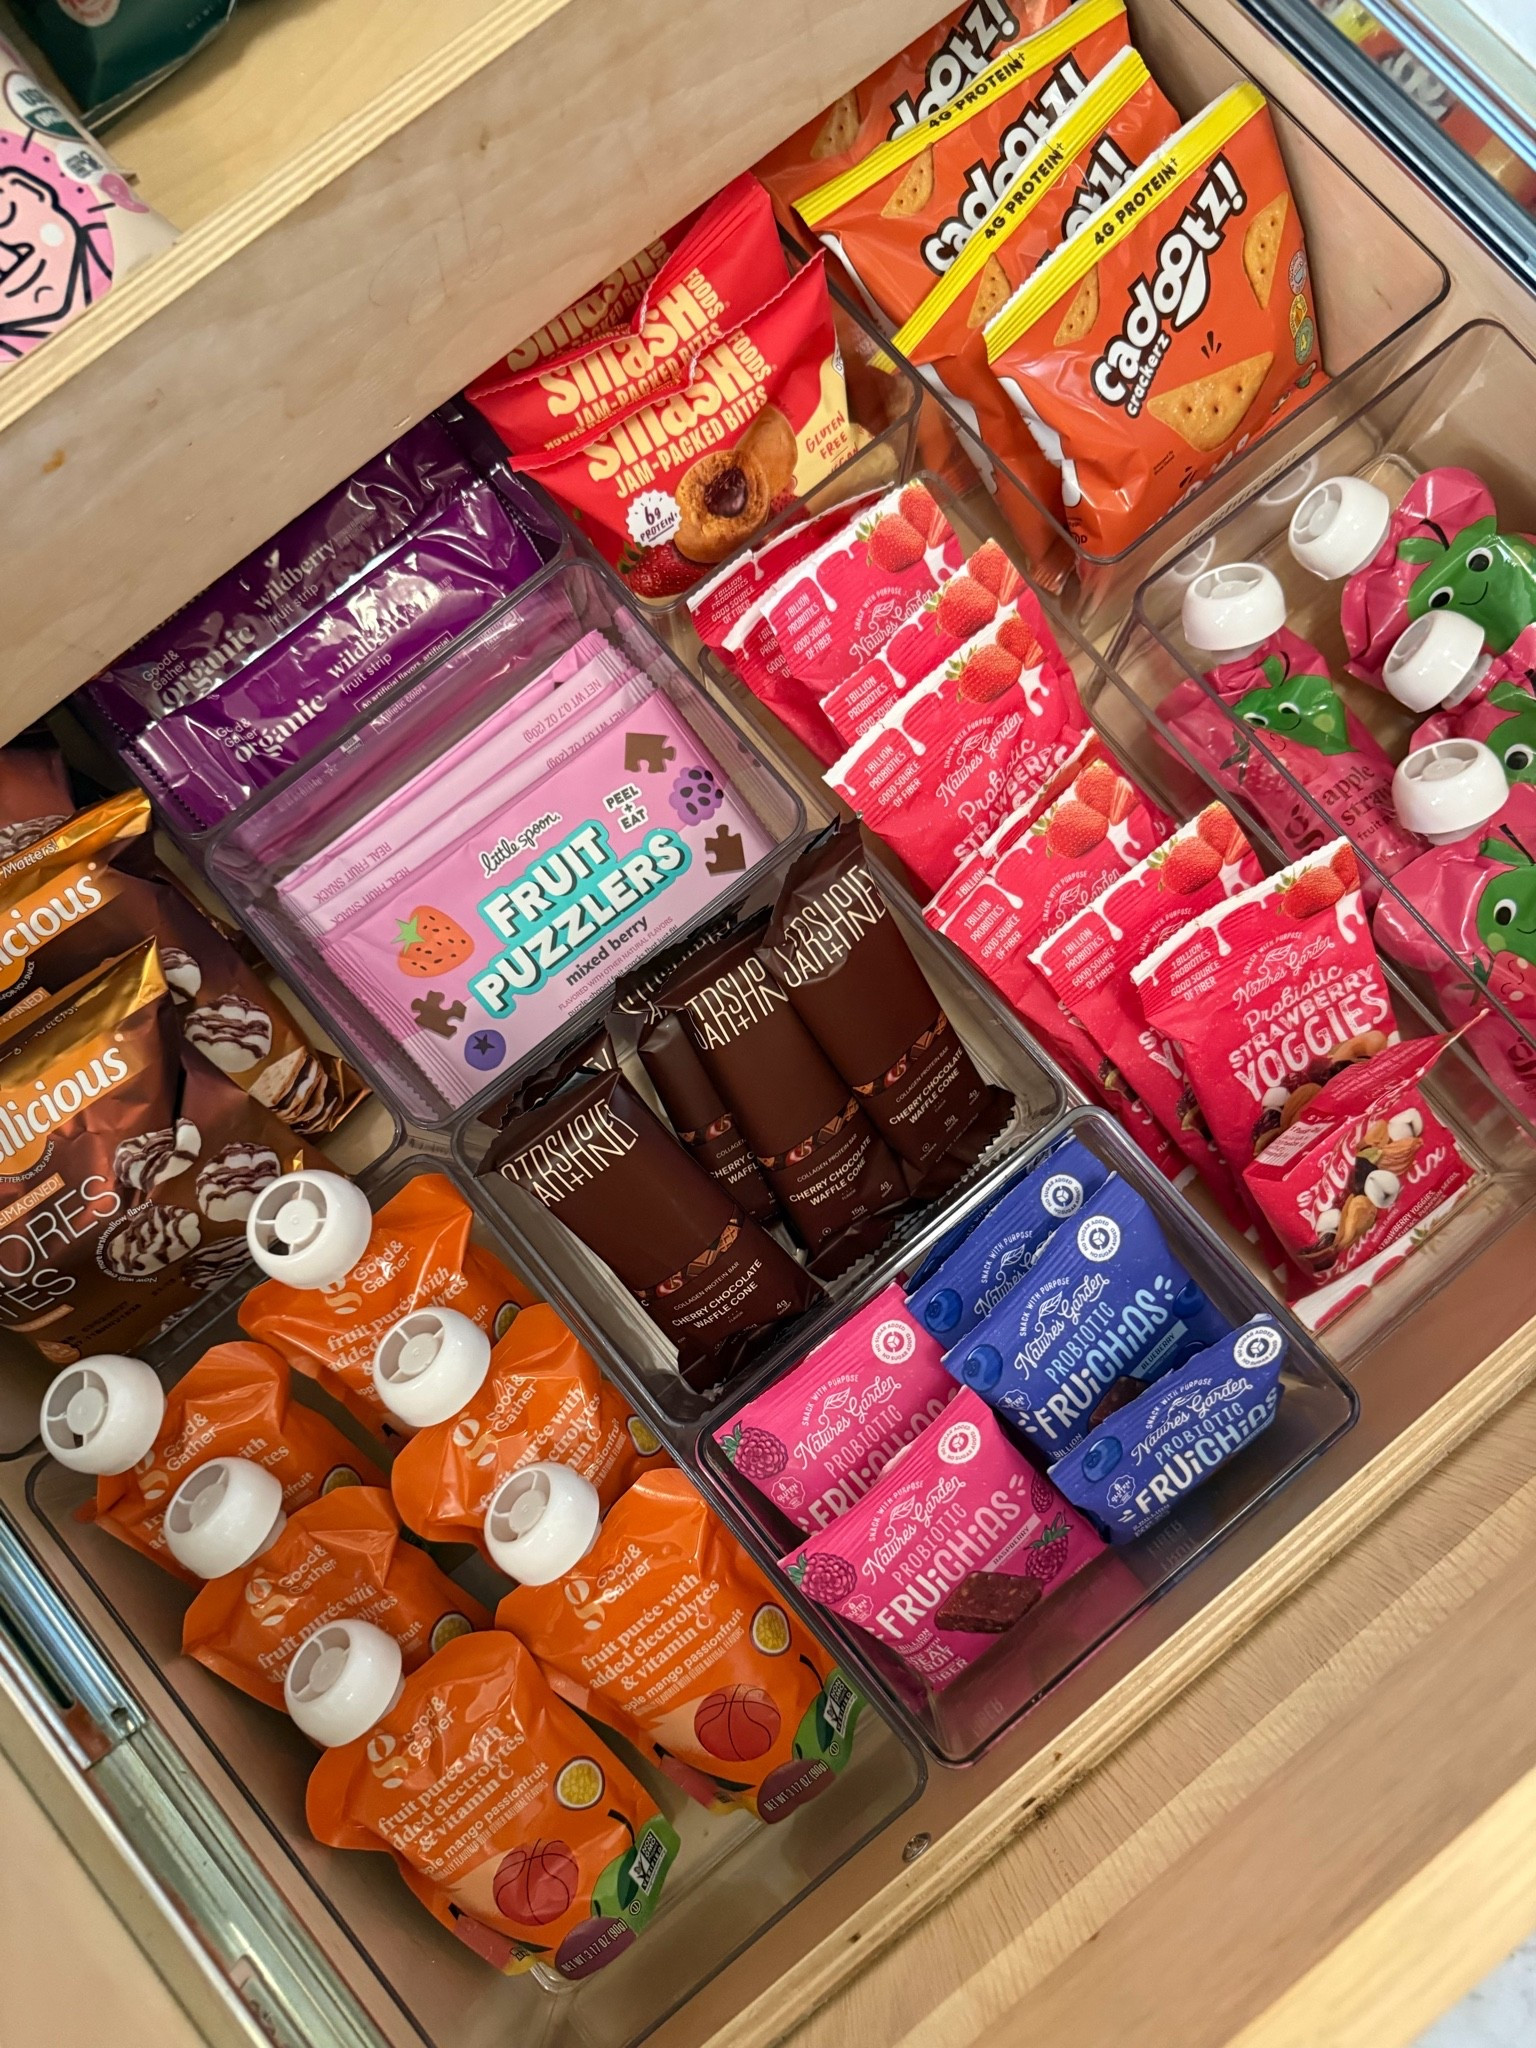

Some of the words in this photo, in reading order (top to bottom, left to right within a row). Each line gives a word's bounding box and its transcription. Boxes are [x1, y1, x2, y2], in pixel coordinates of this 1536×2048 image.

[929, 110, 951, 128] 4G
[983, 213, 1006, 240] 4G
[1094, 221, 1115, 246] 4G
[683, 267, 725, 320] FOODS
[727, 330, 772, 383] FOODS
[1127, 334, 1170, 417] crackerz
[614, 419, 725, 498] JAM-PACKED
[720, 384, 768, 433] BITES
[805, 410, 846, 454] GLUTEN
[819, 431, 848, 460] FREE
[644, 504, 662, 526] 6g
[294, 583, 320, 608] strip
[162, 626, 256, 707] organic
[254, 539, 337, 611] wildberry
[142, 649, 180, 683] Good&
[151, 660, 187, 692] Gather
[341, 672, 366, 696] fruit
[367, 652, 393, 677] strip
[586, 679, 603, 696] NET
[570, 689, 587, 706] WT
[234, 693, 328, 764] organic
[981, 711, 1024, 759] Garden
[868, 751, 907, 791] PROBIOTICS
[869, 744, 894, 772] BILLION
[605, 785, 639, 810] PEEL
[878, 784, 898, 806] GOOD
[894, 760, 921, 789] SOURCE
[902, 778, 922, 801] FIBER
[1321, 766, 1375, 806] apple
[619, 808, 648, 830] EAT
[3, 838, 60, 879] Matters!
[344, 859, 370, 881] FRUIT
[366, 841, 393, 863] REAL
[480, 837, 520, 873] little
[312, 877, 346, 904] SNACK
[483, 826, 609, 938] FRUIT
[474, 833, 685, 1013] PUZZLERS
[558, 987, 589, 1011] FLAVORED
[587, 973, 604, 988] WITH
[622, 936, 649, 961] NATURAL
[647, 916, 674, 939] FLAVORS
[565, 946, 610, 987] mixed
[607, 916, 649, 951] berry
[1072, 966, 1094, 988] GOOD
[1091, 944, 1117, 972] SOURCE
[1095, 961, 1116, 983] FIBER
[1170, 950, 1211, 982] PROBIOTICS
[1286, 936, 1335, 975] Garden
[1170, 980, 1191, 997] GOOD
[1190, 960, 1220, 987] SOURCE
[1194, 977, 1217, 997] FIBER
[1243, 965, 1343, 1033] Probiotic
[1228, 964, 1374, 1069] STRAWBERRY
[1234, 983, 1388, 1102] YOGGIES
[889, 1094, 922, 1125] CHERRY
[922, 1047, 963, 1097] CHOCOLATE
[909, 1091, 938, 1124] WAFFLE
[937, 1068, 960, 1093] CONE
[789, 1178, 828, 1202] CHERRY
[829, 1135, 871, 1182] CHOCOLATE
[797, 1160, 829, 1183] COLLAGEN
[828, 1143, 850, 1164] PROTEIN
[809, 1178, 848, 1206] WAFFLE
[847, 1157, 866, 1182] CONE
[98, 1215, 127, 1254] marshmallow
[127, 1199, 154, 1217] flavor!
[1003, 1230, 1033, 1246] PURPOSE
[326, 1324, 371, 1352] fruit
[417, 1266, 450, 1298] with
[672, 1306, 710, 1327] CHERRY
[709, 1259, 762, 1309] CHOCOLATE
[673, 1291, 705, 1311] COLLAGEN
[704, 1272, 729, 1293] PROTEIN
[693, 1303, 732, 1329] WAFFLE
[730, 1281, 759, 1306] CONE
[1020, 1312, 1030, 1337] SNACK
[1027, 1294, 1041, 1310] WITH
[1040, 1277, 1070, 1295] PURPOSE
[1058, 1273, 1110, 1326] Garden
[1045, 1301, 1116, 1385] PROBIOTIC
[1140, 1334, 1176, 1370] BLUEBERRY
[494, 1384, 537, 1432] Gather
[552, 1387, 583, 1425] with
[801, 1406, 814, 1427] SNACK
[810, 1385, 828, 1402] WITH
[827, 1374, 859, 1389] PURPOSE
[844, 1374, 902, 1425] Garden
[1186, 1377, 1253, 1419] Garden
[166, 1426, 218, 1472] Gather
[824, 1404, 904, 1480] PROBIOTIC
[1154, 1402, 1245, 1466] PROBIOTIC
[892, 1480, 924, 1499] PURPOSE
[911, 1475, 967, 1529] Garden
[278, 1544, 328, 1589] Good&
[597, 1543, 643, 1589] Good&
[892, 1502, 968, 1586] PROBIOTIC
[993, 1526, 1031, 1566] RASPBERRY
[289, 1559, 337, 1594] Gather
[602, 1559, 652, 1604] Gather
[257, 1635, 301, 1669] fruit
[344, 1582, 378, 1606] with
[581, 1640, 620, 1672] fruit
[617, 1605, 664, 1649] purée
[661, 1573, 700, 1608] with
[589, 1649, 635, 1689] added
[633, 1579, 721, 1657] electrolytes
[620, 1674, 639, 1691] &
[636, 1627, 699, 1679] vitamin
[695, 1613, 712, 1631] C
[645, 1665, 684, 1699] mango
[683, 1608, 744, 1670] passionfruit
[378, 1800, 420, 1836] fruit
[464, 1726, 506, 1764] with
[434, 1732, 526, 1817] electrolytes
[763, 1796, 780, 1812] NET
[809, 1760, 829, 1780] (90g)
[418, 1829, 440, 1853] &
[436, 1778, 502, 1837] vitamin
[498, 1764, 515, 1781] C
[443, 1820, 484, 1860] mango
[483, 1761, 550, 1825] passionfruit
[642, 1834, 653, 1853] NON
[561, 1957, 577, 1972] NET
[573, 1954, 588, 1966] WT
[584, 1942, 601, 1960] 3.17
[607, 1917, 629, 1940] (90g)
